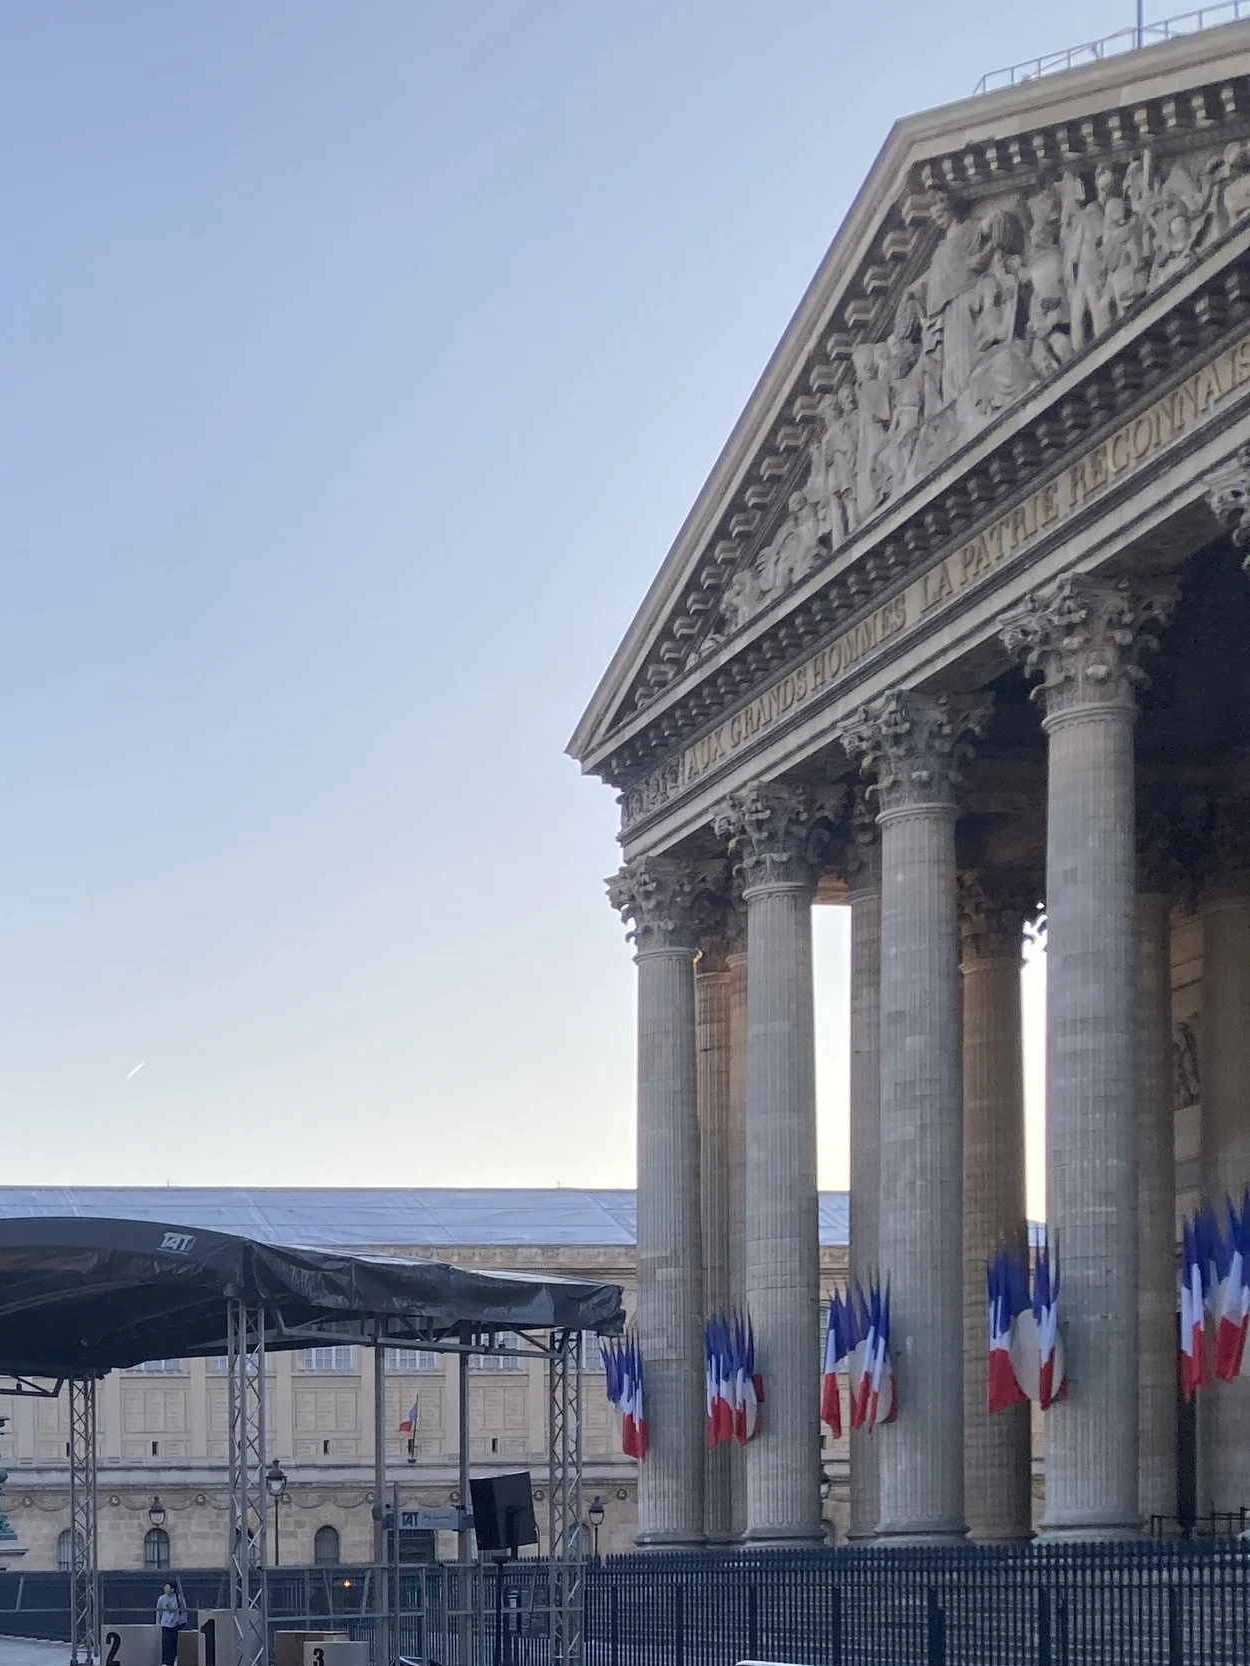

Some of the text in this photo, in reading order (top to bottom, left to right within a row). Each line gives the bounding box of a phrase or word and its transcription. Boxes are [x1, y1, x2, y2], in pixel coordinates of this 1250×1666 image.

[686, 730, 726, 778] AUX
[730, 672, 807, 749] GRANDS
[811, 597, 907, 692] HOMMES
[921, 562, 953, 613] LA
[960, 482, 1060, 586] PATRIE
[401, 1511, 419, 1527] TAT
[105, 1632, 121, 1666] 2
